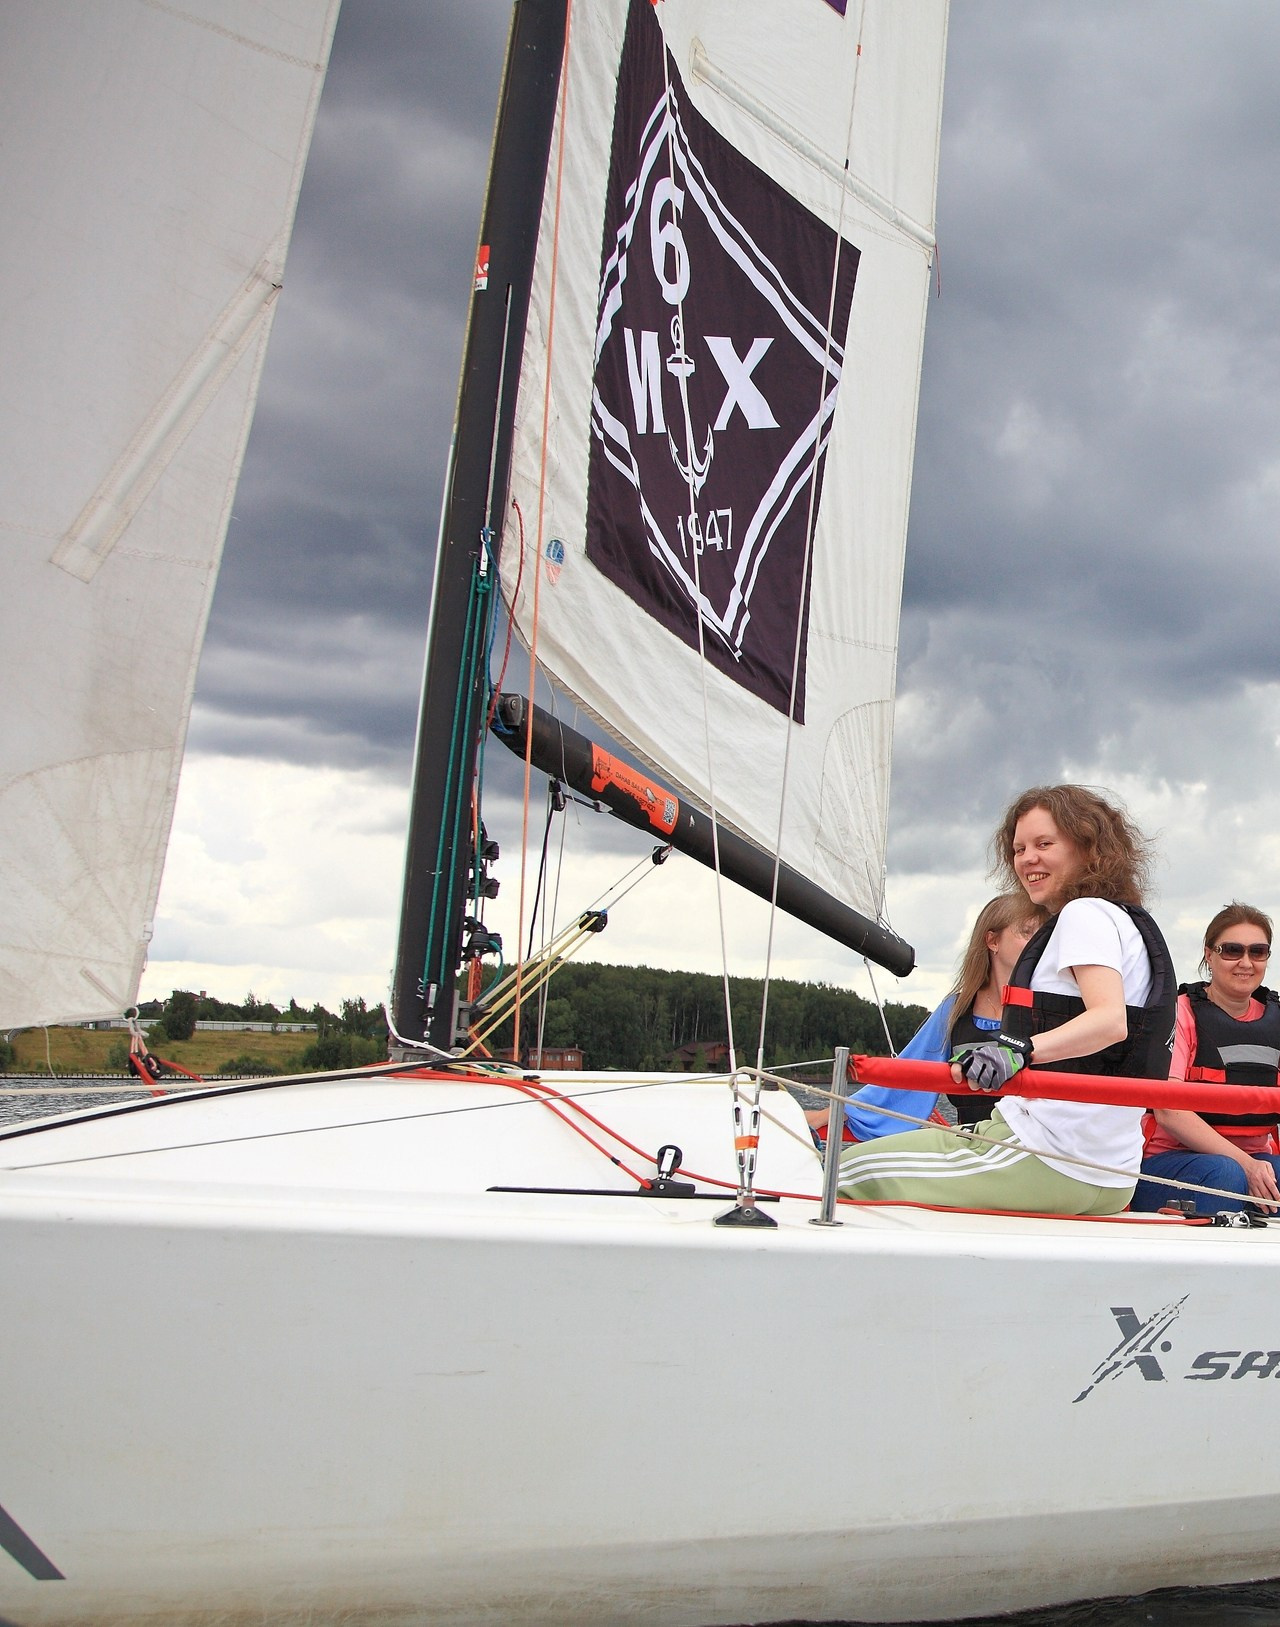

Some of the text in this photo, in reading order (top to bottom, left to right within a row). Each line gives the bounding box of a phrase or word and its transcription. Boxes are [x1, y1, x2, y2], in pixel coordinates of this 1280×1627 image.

[650, 177, 690, 305] 6
[703, 335, 781, 431] X
[677, 507, 733, 558] 1947
